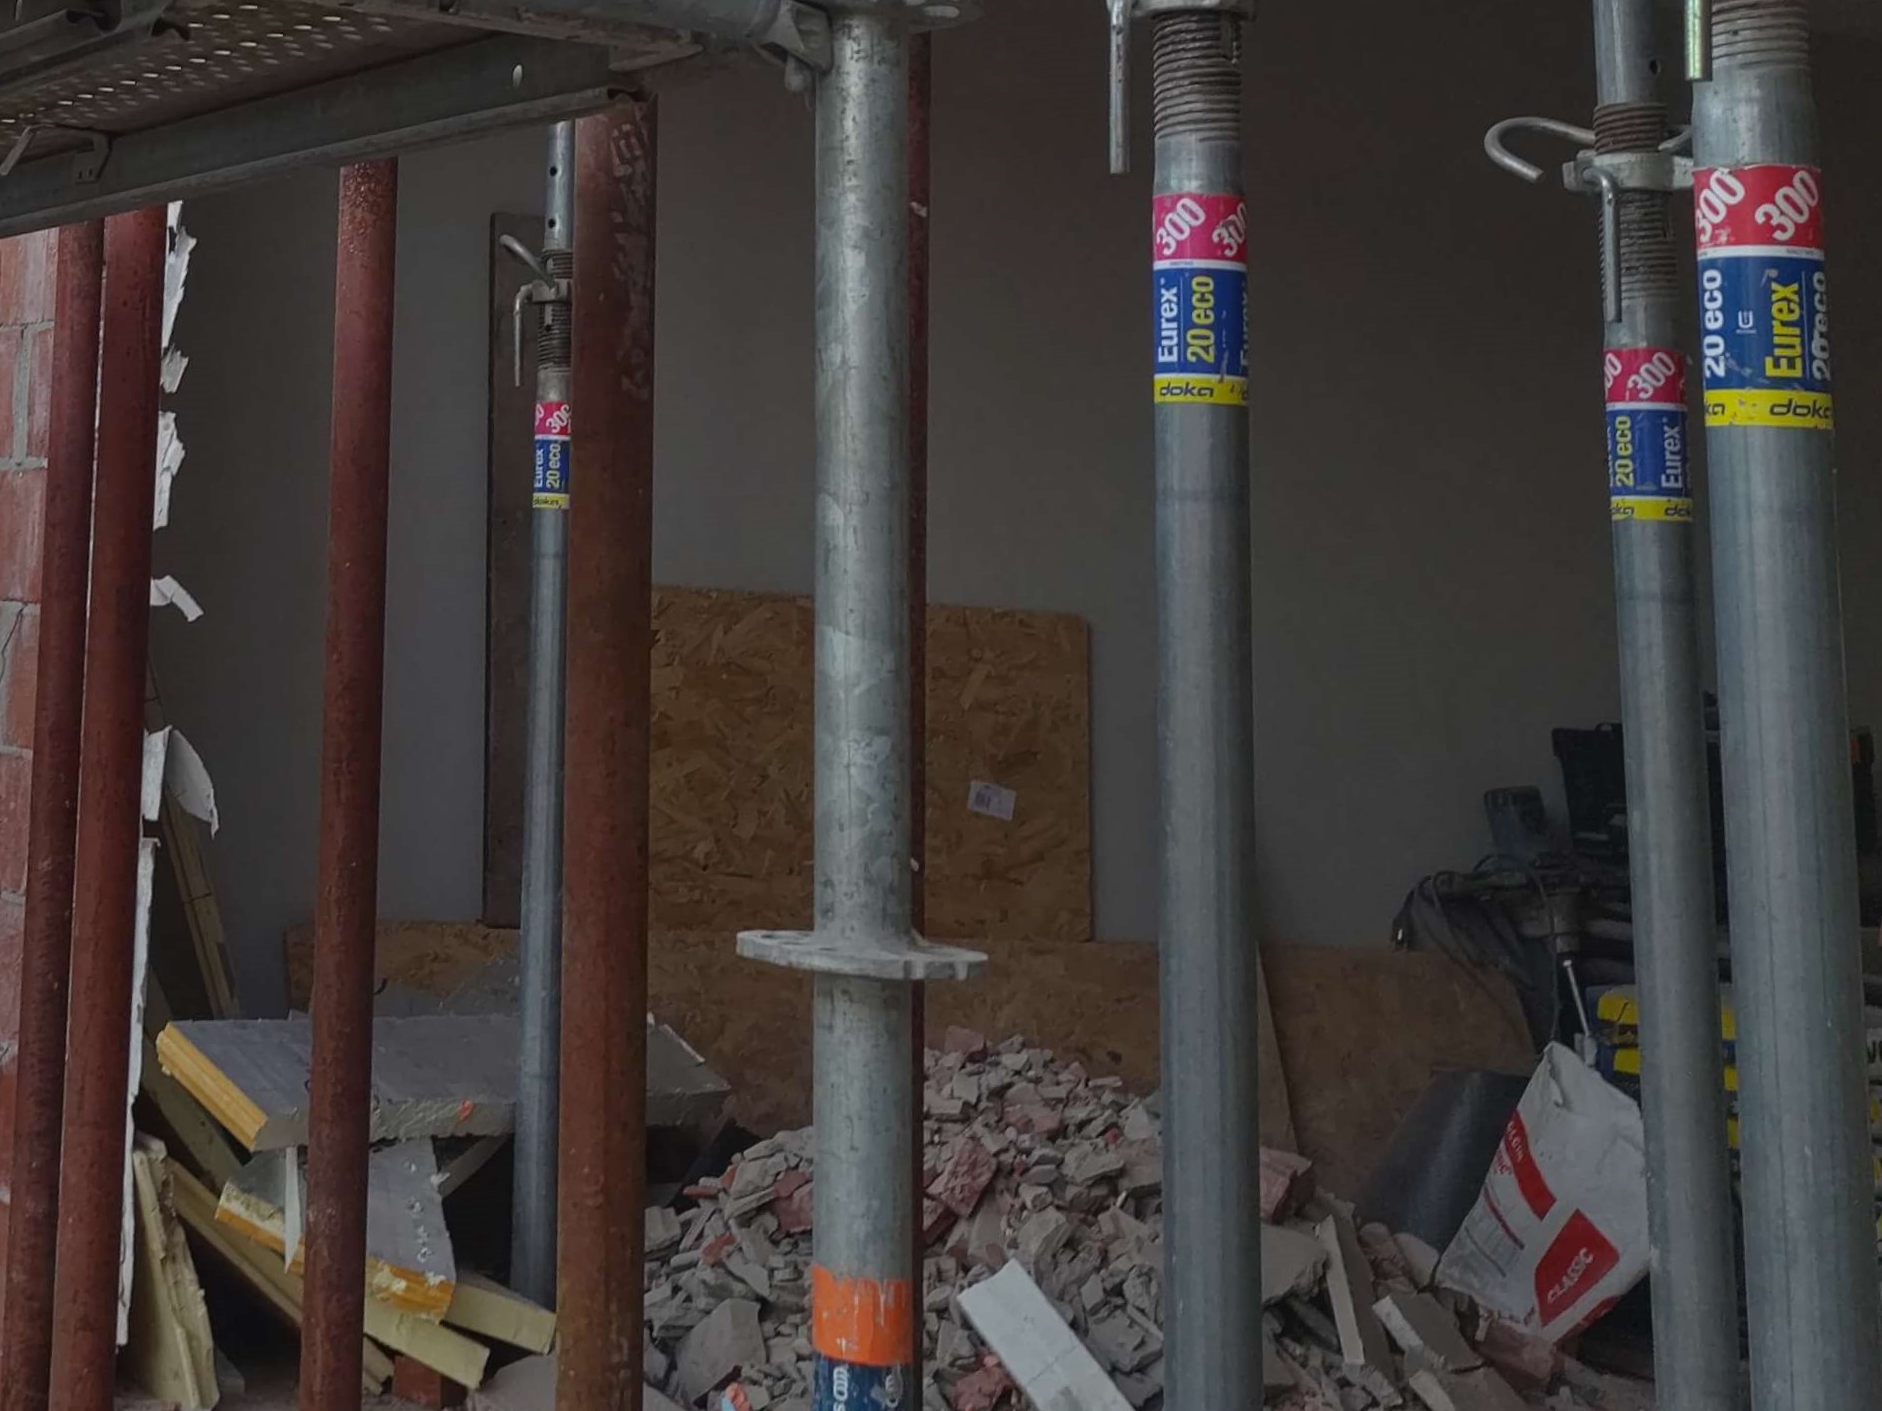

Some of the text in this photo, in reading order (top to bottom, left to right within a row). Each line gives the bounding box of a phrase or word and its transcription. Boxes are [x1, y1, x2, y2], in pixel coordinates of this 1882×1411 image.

[1156, 197, 1206, 256] 300
[1754, 170, 1819, 241] 300
[1186, 275, 1215, 364] 20 eco
[1702, 268, 1724, 330] eco
[1626, 352, 1676, 399] 300
[1704, 339, 1726, 379] 20
[1812, 340, 1832, 381] 20
[1159, 381, 1215, 398] doka
[546, 443, 561, 489] 20 eco
[1615, 415, 1634, 488] 20 eco
